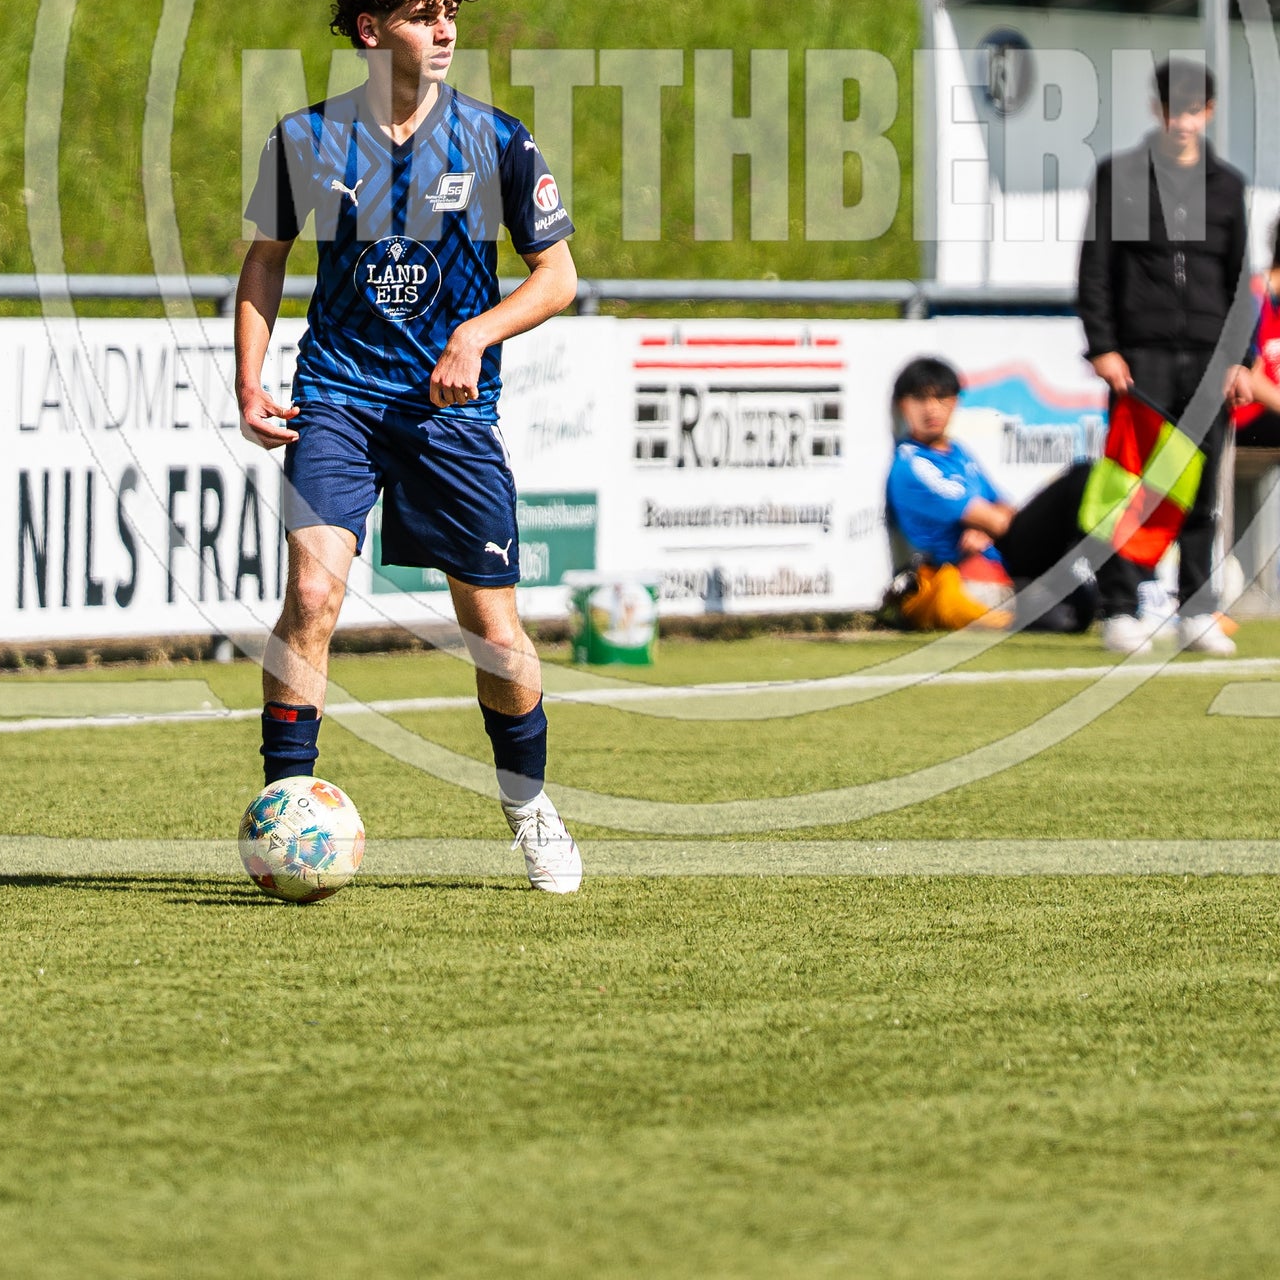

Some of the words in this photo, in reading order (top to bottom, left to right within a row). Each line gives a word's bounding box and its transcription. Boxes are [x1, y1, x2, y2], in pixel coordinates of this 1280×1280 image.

[366, 263, 428, 286] LAND
[375, 283, 419, 305] EIS
[16, 465, 138, 609] NILS
